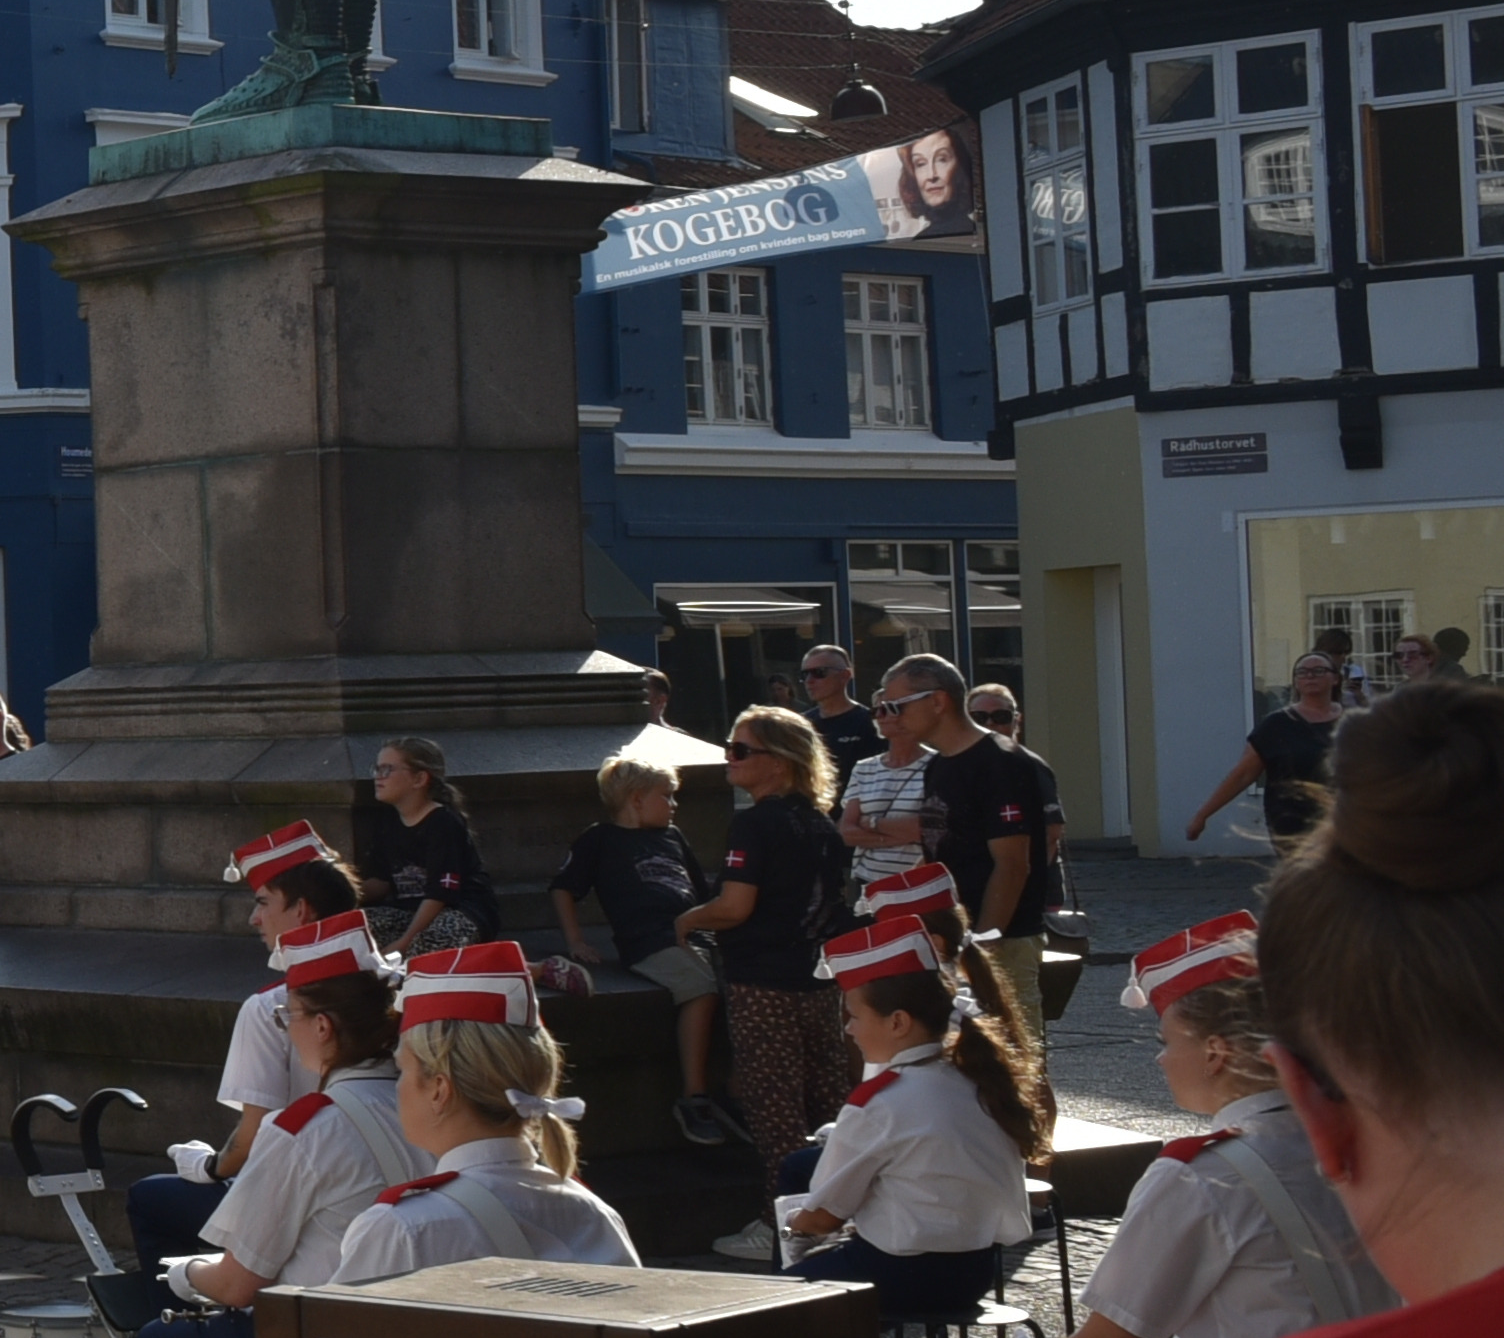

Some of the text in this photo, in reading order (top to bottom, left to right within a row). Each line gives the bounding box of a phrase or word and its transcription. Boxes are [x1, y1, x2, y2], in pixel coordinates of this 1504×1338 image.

[623, 191, 830, 261] KOGEBOG
[595, 227, 867, 284] En musikalsk forestilling om kvinden bag bogen
[1170, 436, 1257, 453] Rådhustorvet
